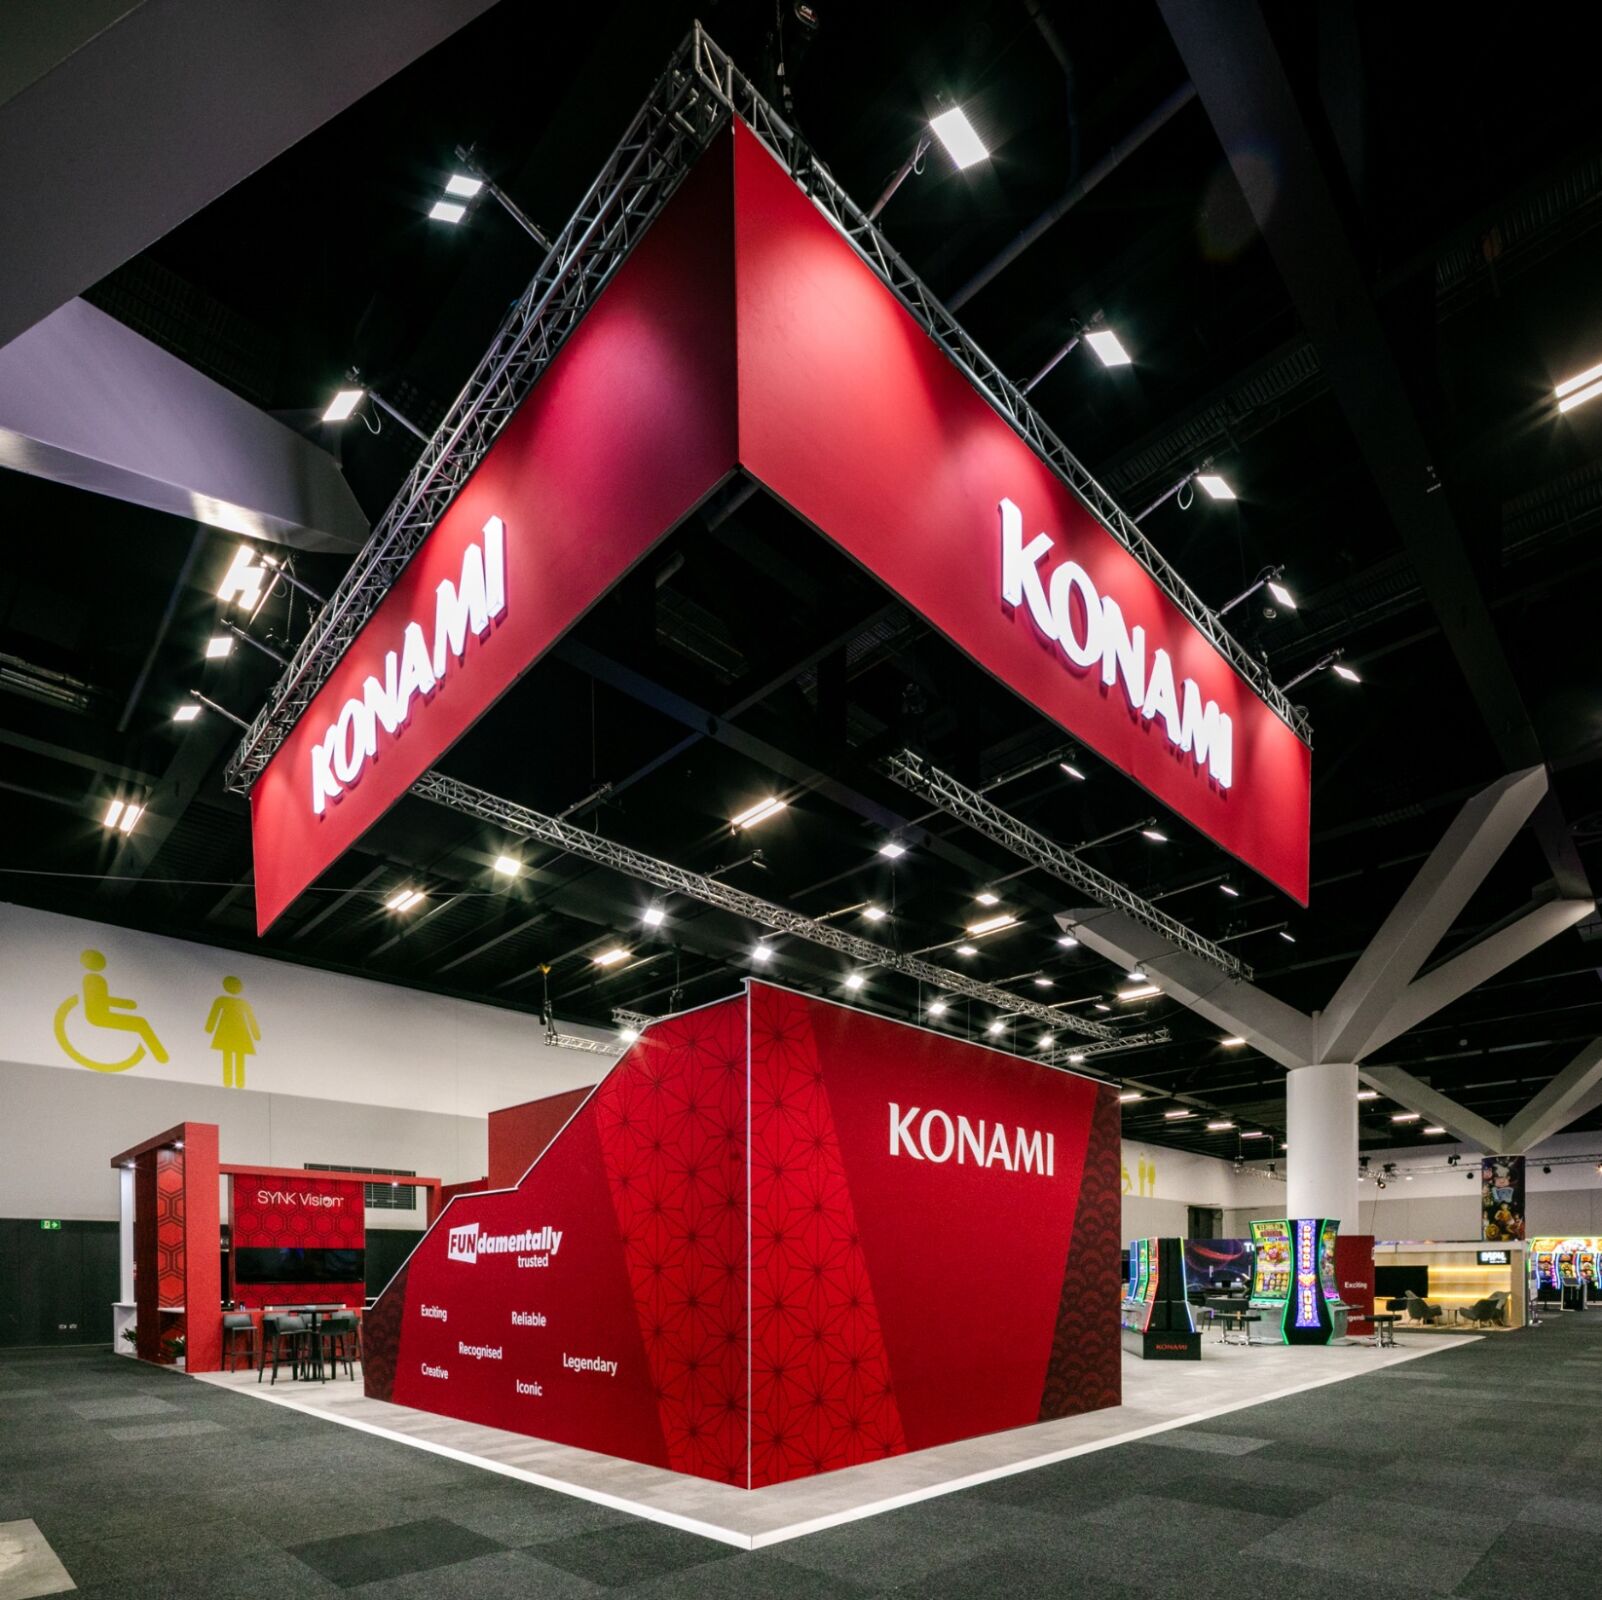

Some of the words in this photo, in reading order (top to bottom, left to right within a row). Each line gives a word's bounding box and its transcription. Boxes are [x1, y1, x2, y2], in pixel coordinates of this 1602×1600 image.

[1000, 497, 1232, 788] KONAMI
[311, 515, 505, 815] KONAMI
[888, 1102, 1054, 1176] KONAMI
[257, 1190, 296, 1205] SYNK
[448, 1224, 563, 1258] FUNdamentally
[517, 1253, 549, 1268] trusted
[1344, 1281, 1368, 1290] Exciting
[421, 1304, 448, 1322] Exciting
[511, 1311, 547, 1327] Reliable
[459, 1341, 503, 1359] Recognised
[421, 1363, 449, 1380] Creative
[563, 1353, 618, 1376] Legendary
[516, 1379, 543, 1397] Iconic
